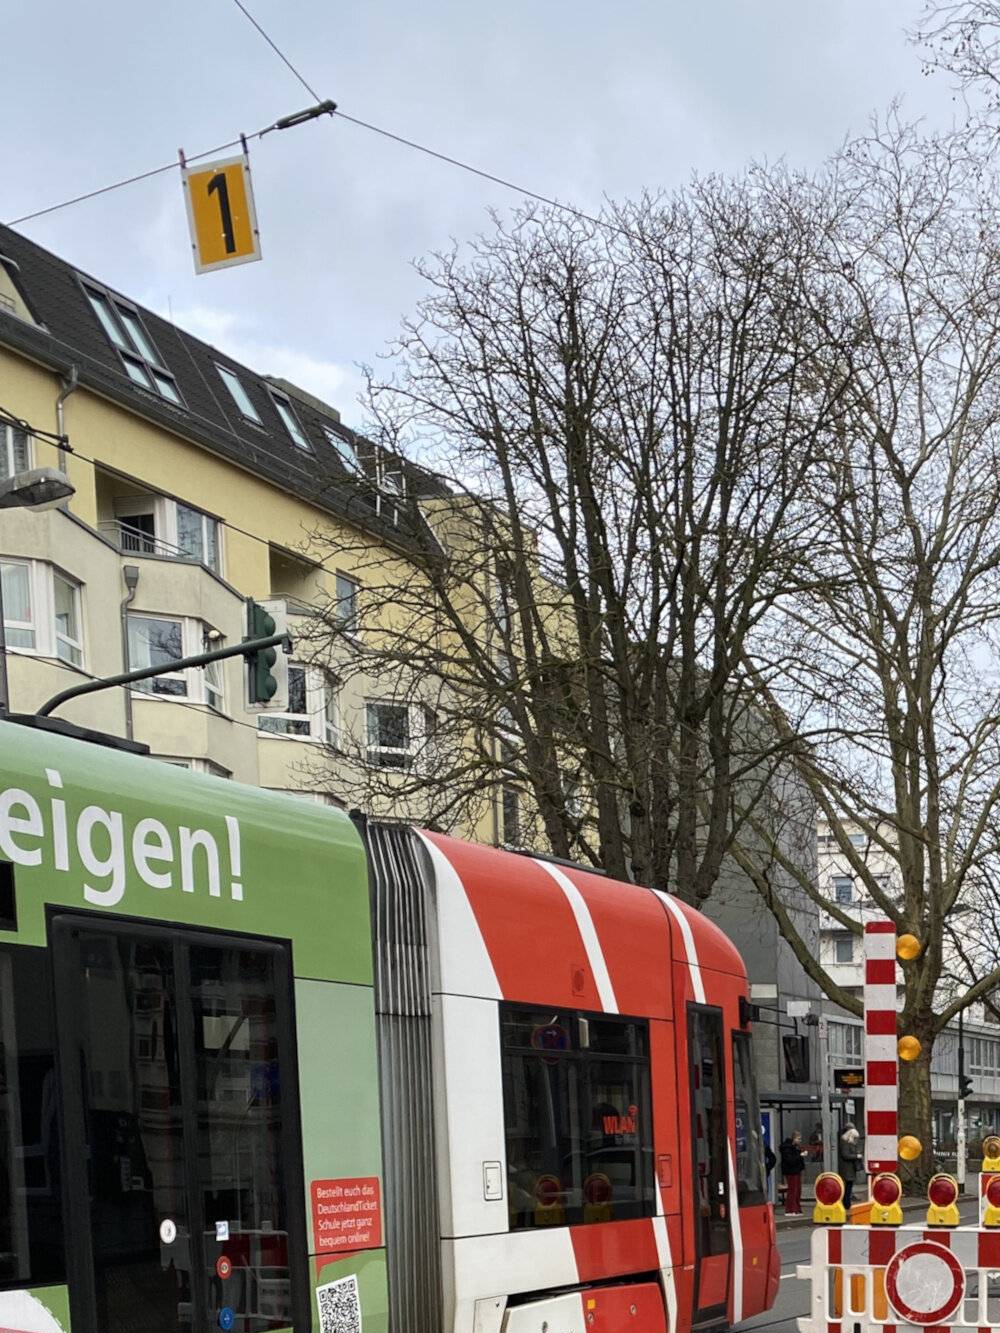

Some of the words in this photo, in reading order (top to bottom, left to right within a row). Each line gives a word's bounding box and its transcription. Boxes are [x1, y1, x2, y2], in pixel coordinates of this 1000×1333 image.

[207, 172, 237, 254] 1
[602, 1115, 636, 1135] WLAN
[317, 1187, 343, 1198] Bestellt
[344, 1185, 360, 1196] euch
[362, 1185, 374, 1196] das
[318, 1218, 340, 1231] Schule
[356, 1217, 373, 1230] ganz
[319, 1235, 347, 1247] bequem
